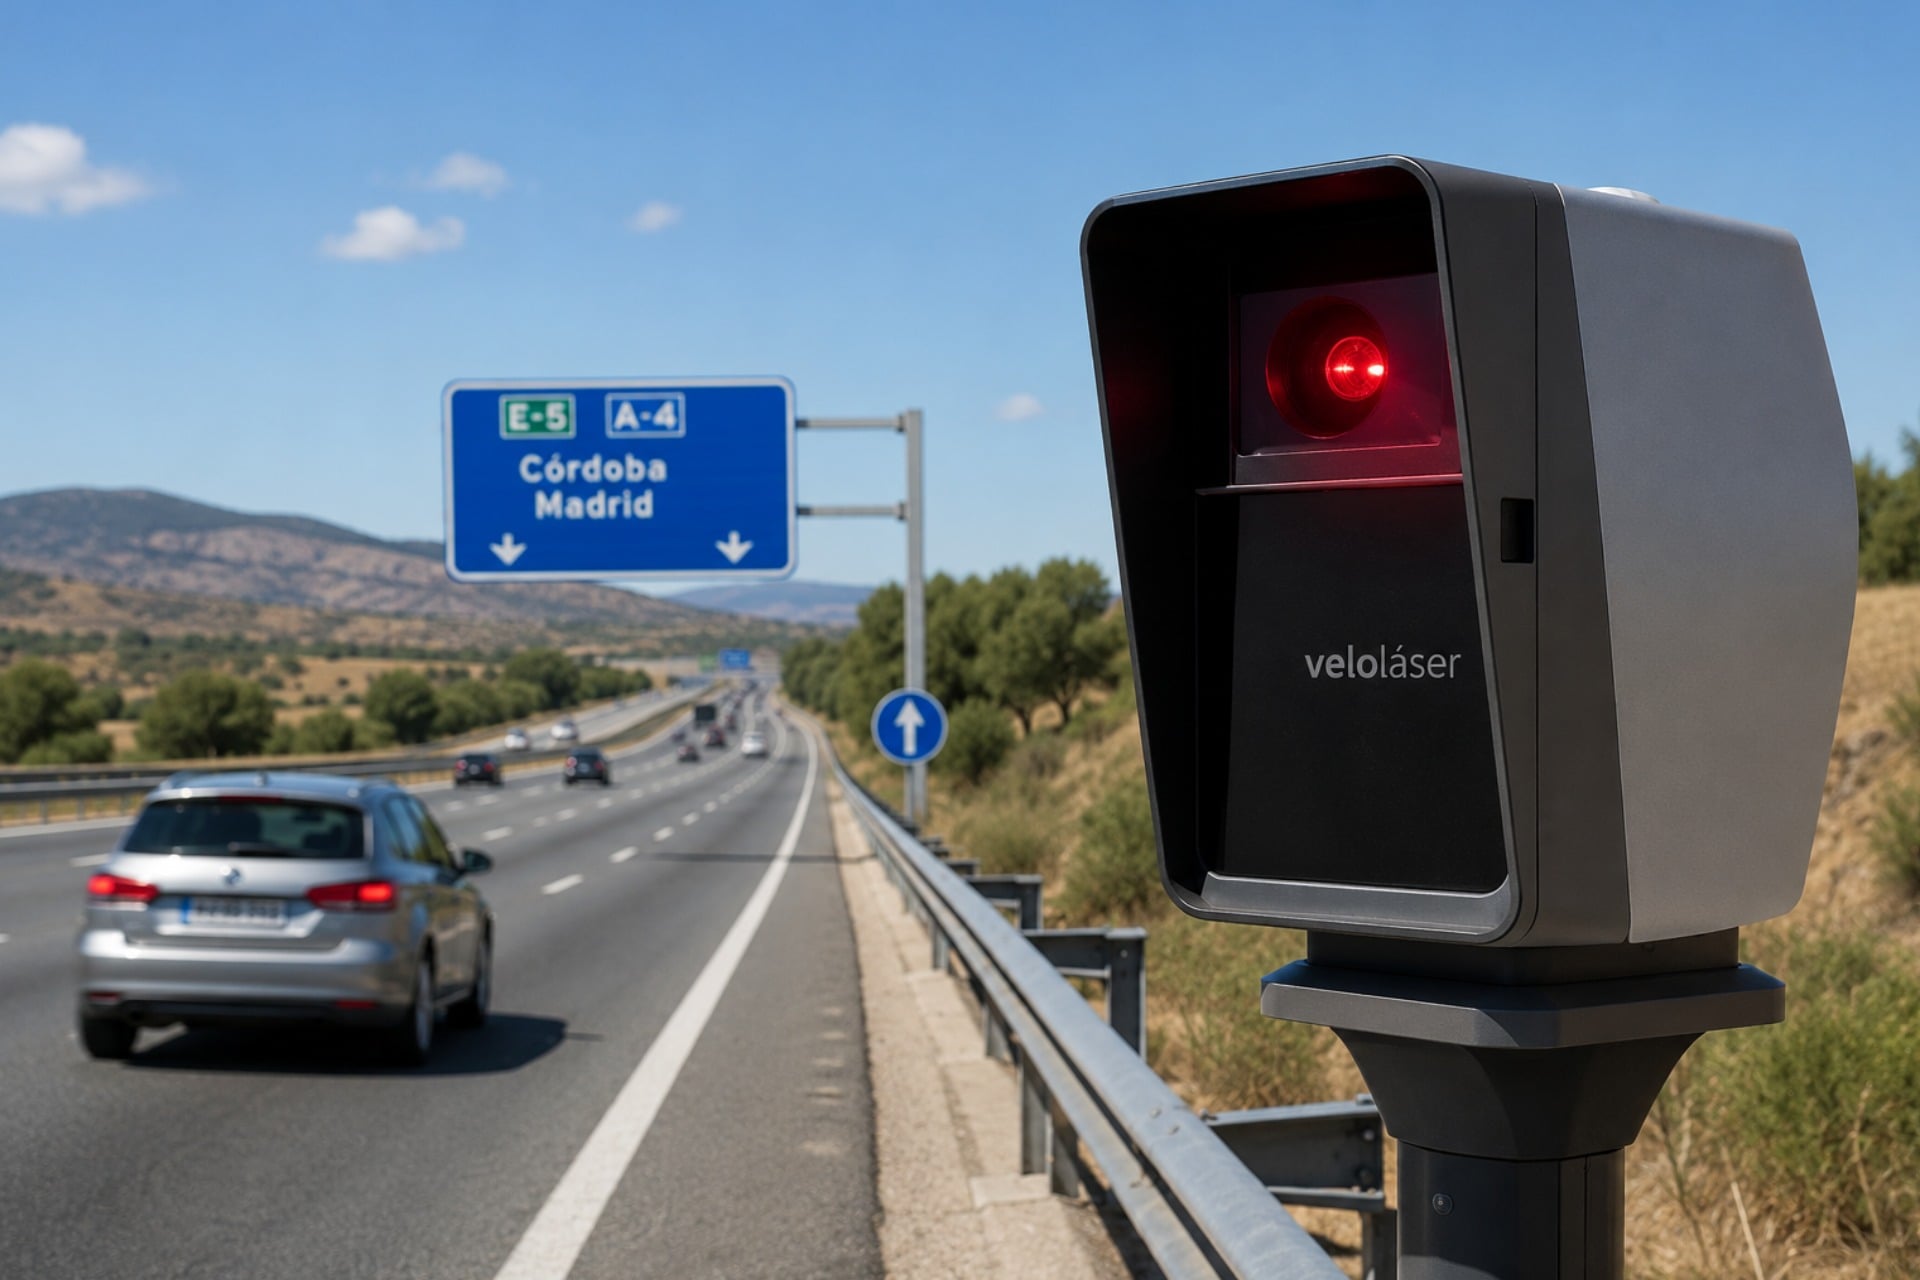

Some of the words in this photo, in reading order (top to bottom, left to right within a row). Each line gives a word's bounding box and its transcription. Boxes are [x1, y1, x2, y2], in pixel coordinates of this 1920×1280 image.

[507, 401, 568, 431] E-5
[613, 400, 678, 430] A-4
[519, 453, 668, 483] Córdoba
[534, 489, 654, 520] Madrid
[1304, 644, 1462, 679] veloláser
